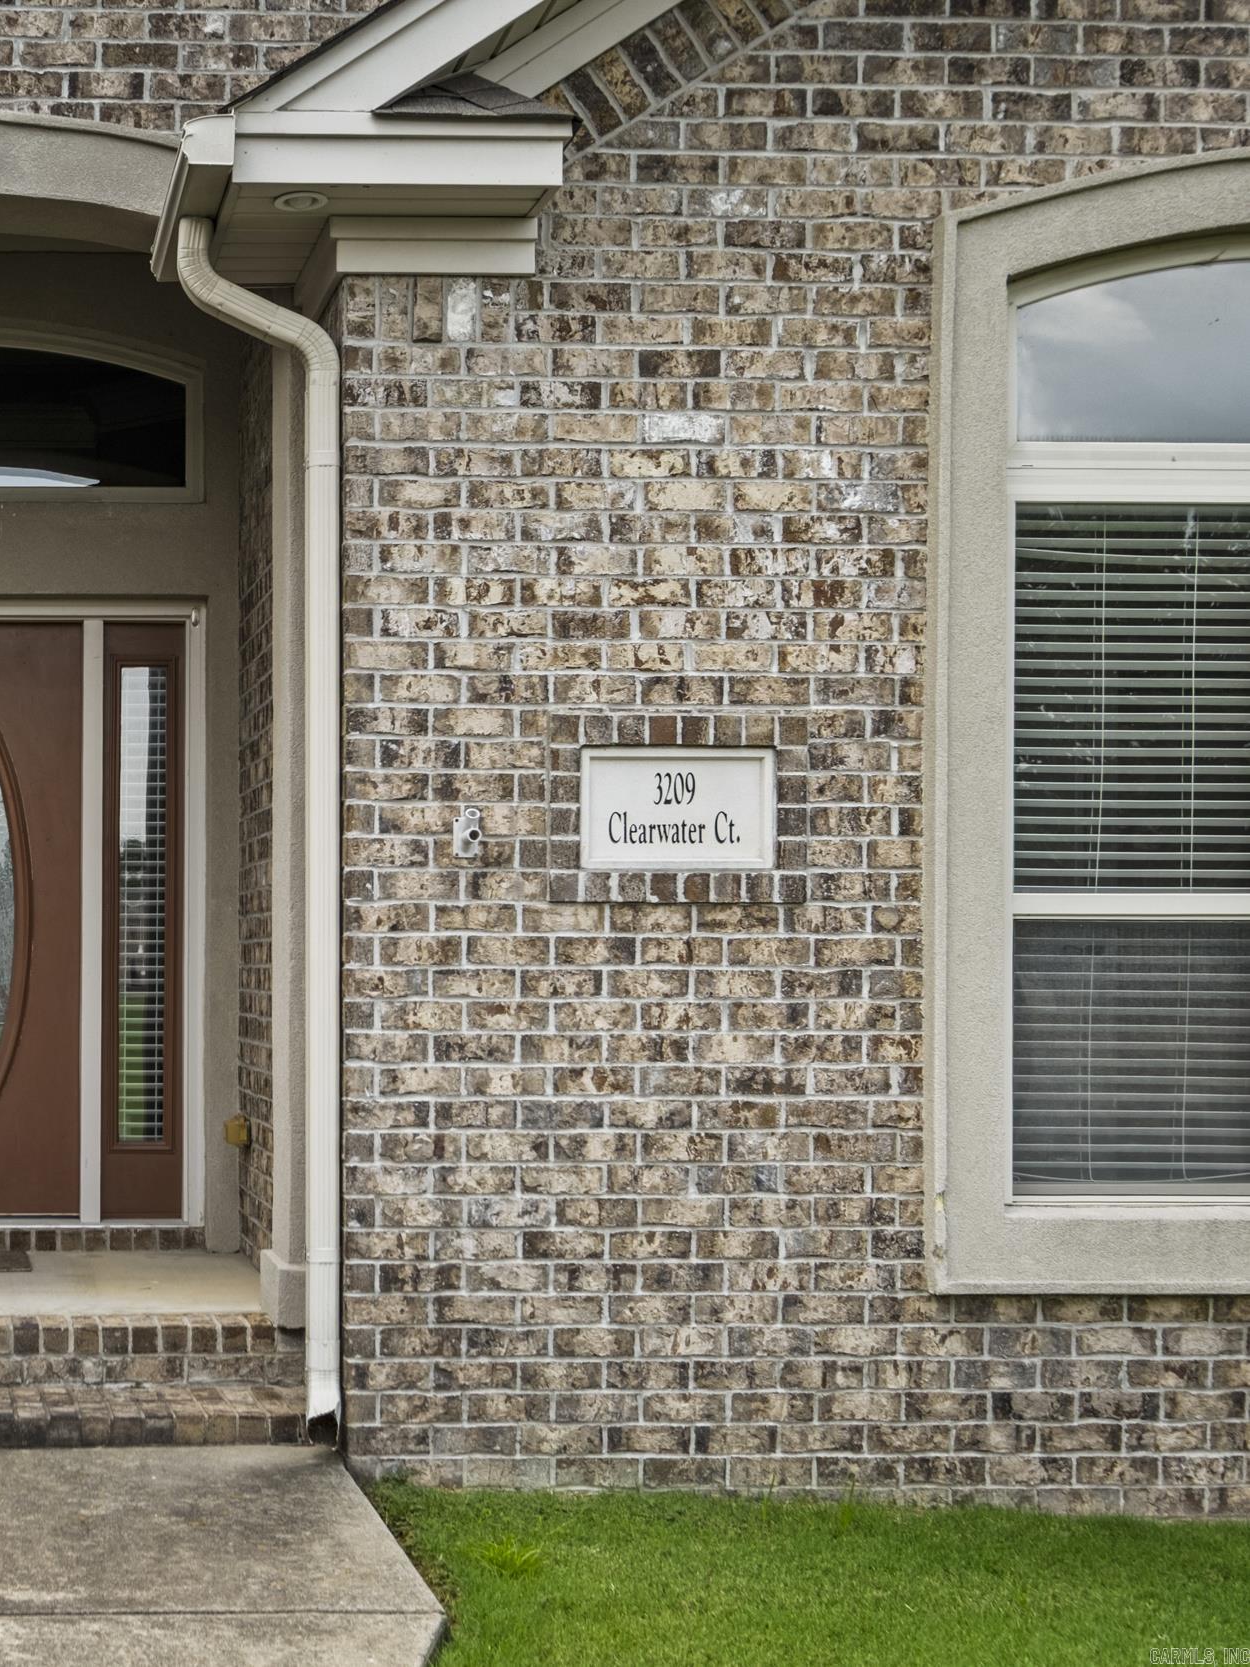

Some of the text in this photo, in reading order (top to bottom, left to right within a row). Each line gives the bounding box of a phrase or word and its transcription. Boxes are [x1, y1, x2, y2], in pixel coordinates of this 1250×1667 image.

[653, 771, 696, 806] 3209
[608, 810, 741, 845] Clearwater Ct.
